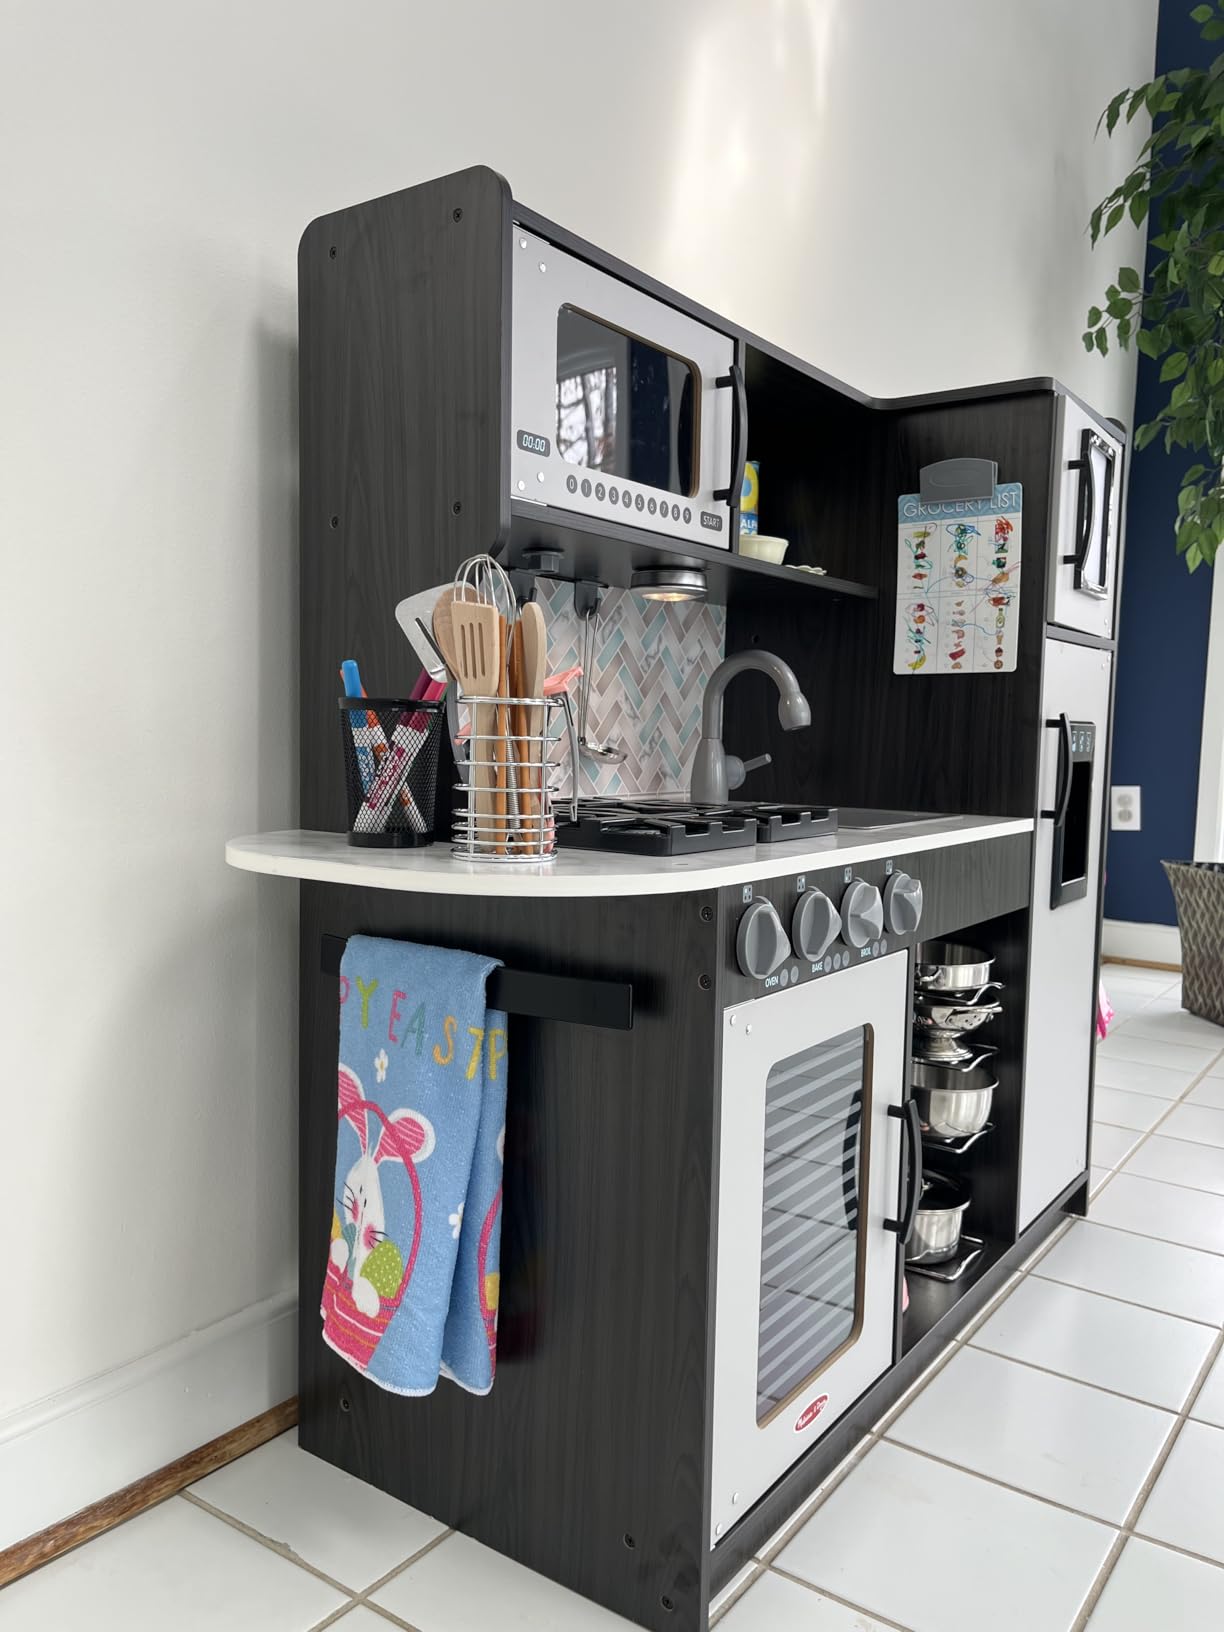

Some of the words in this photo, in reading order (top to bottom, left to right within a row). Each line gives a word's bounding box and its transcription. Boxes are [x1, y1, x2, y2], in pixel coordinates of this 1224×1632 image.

[522, 434, 546, 452] 00:00
[903, 499, 982, 517] GROCERY
[990, 491, 1017, 508] LIST
[703, 515, 720, 528] START
[812, 962, 823, 973] BAKE
[765, 976, 779, 988] OVEN
